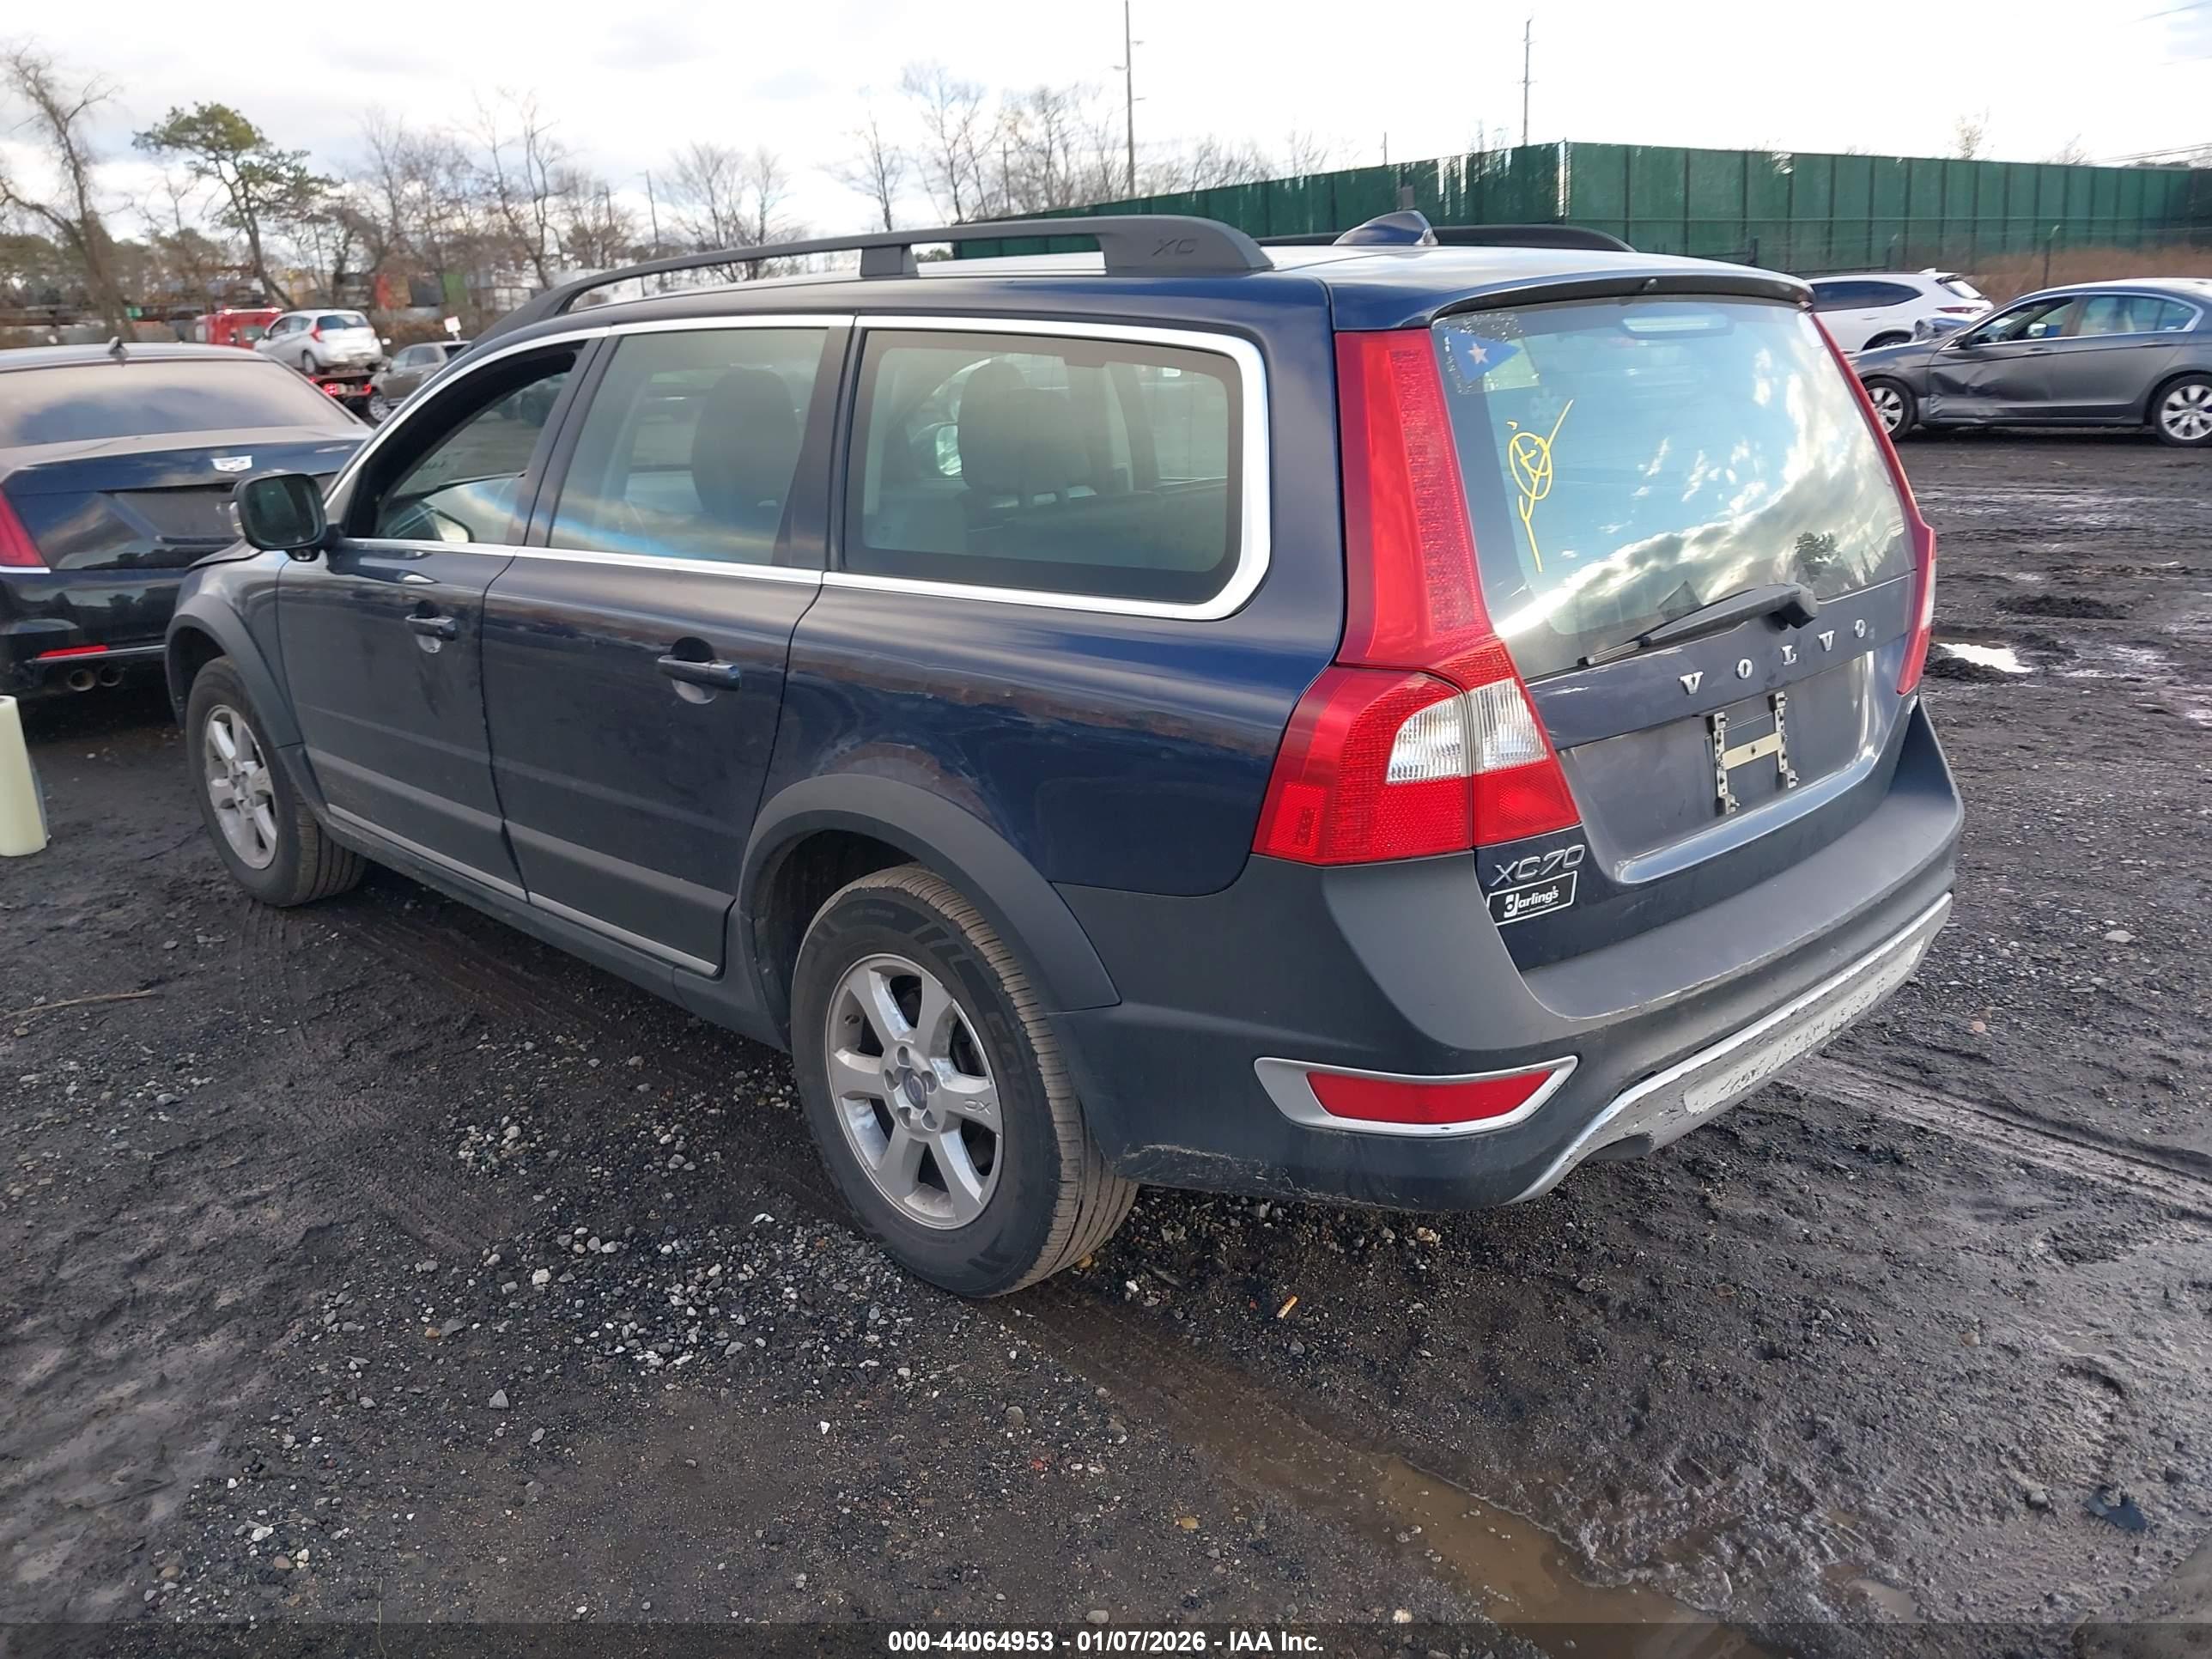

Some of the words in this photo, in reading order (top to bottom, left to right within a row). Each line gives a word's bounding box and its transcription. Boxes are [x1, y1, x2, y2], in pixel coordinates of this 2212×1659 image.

[1152, 238, 1198, 257] XC
[1678, 618, 1867, 695] VOLVO
[1489, 844, 1586, 887] XC70
